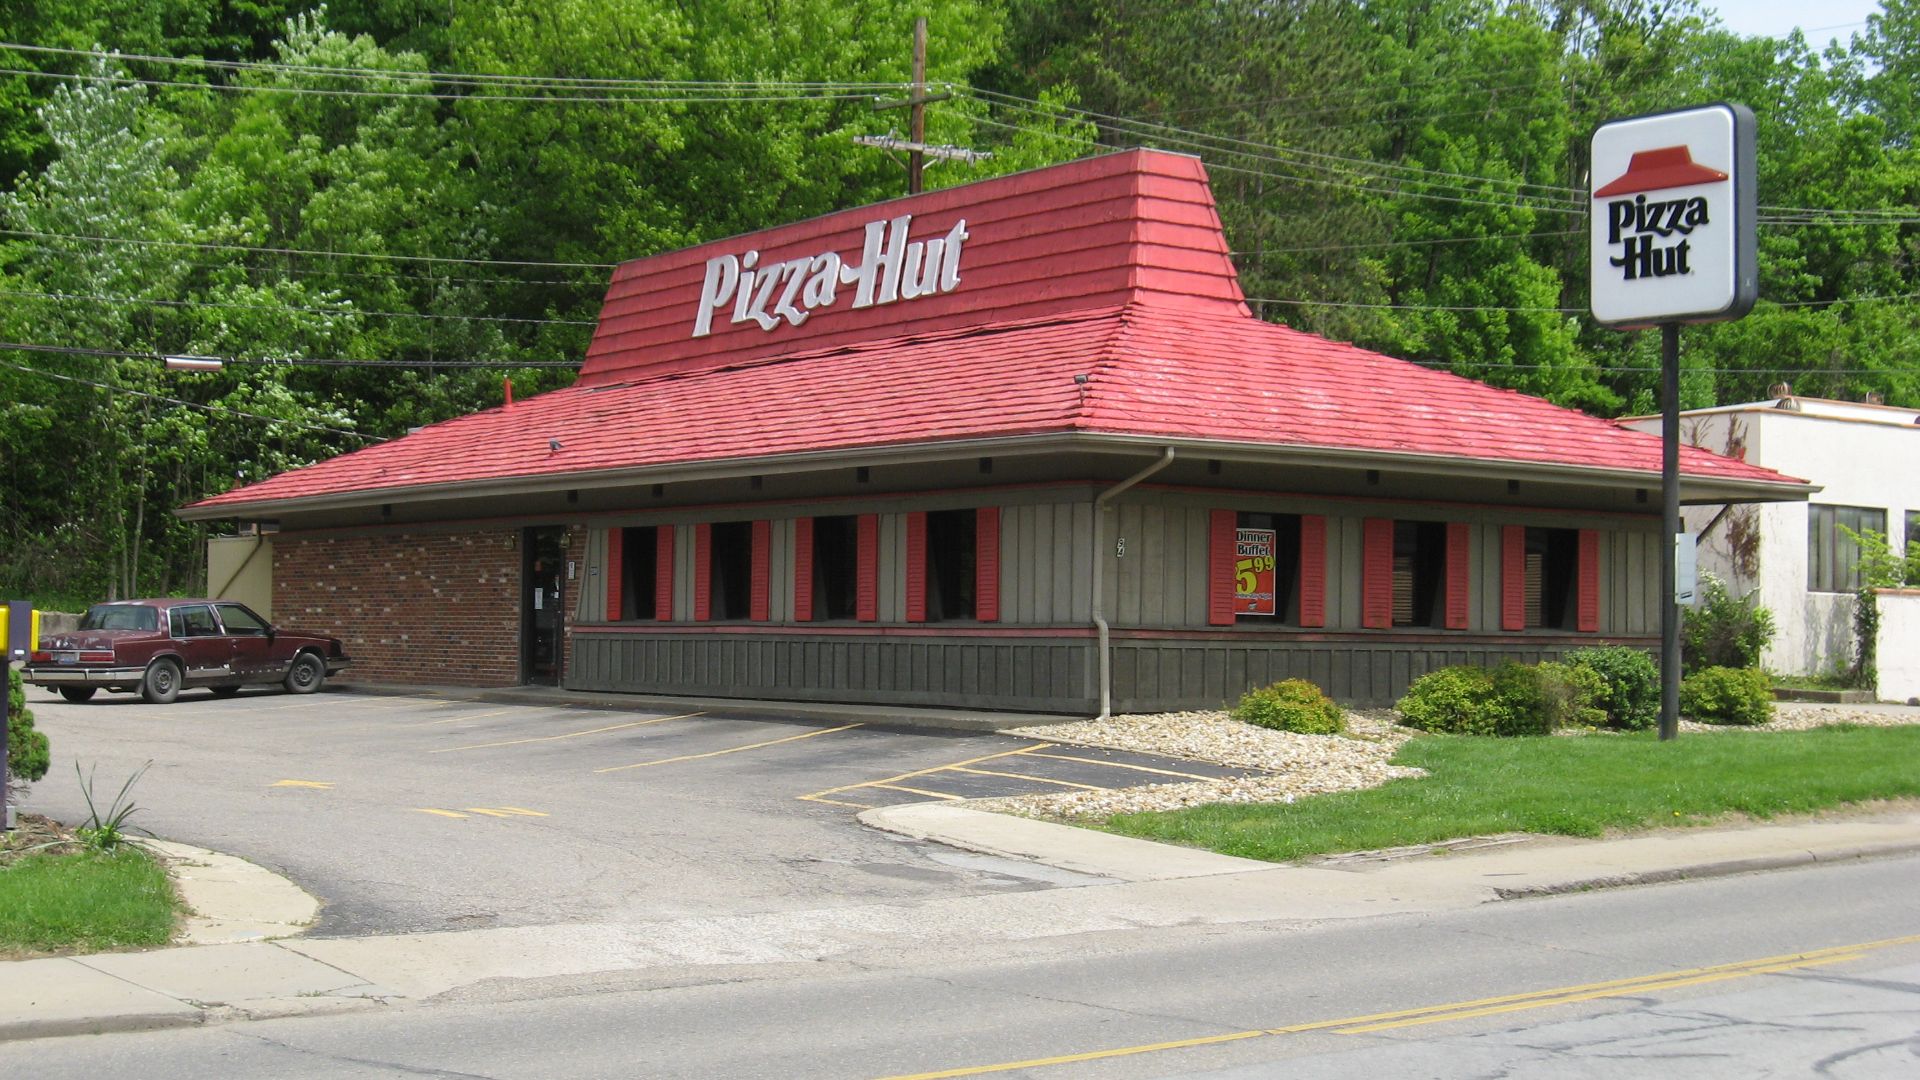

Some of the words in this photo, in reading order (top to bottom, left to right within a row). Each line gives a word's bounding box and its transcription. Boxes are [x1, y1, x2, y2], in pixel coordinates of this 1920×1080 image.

[1608, 194, 1710, 244] Pizza
[691, 250, 841, 338] Pizza
[839, 214, 969, 309] Hut
[1609, 234, 1691, 280] Hut
[1236, 531, 1272, 542] Dinner
[1237, 543, 1270, 556] Buffet
